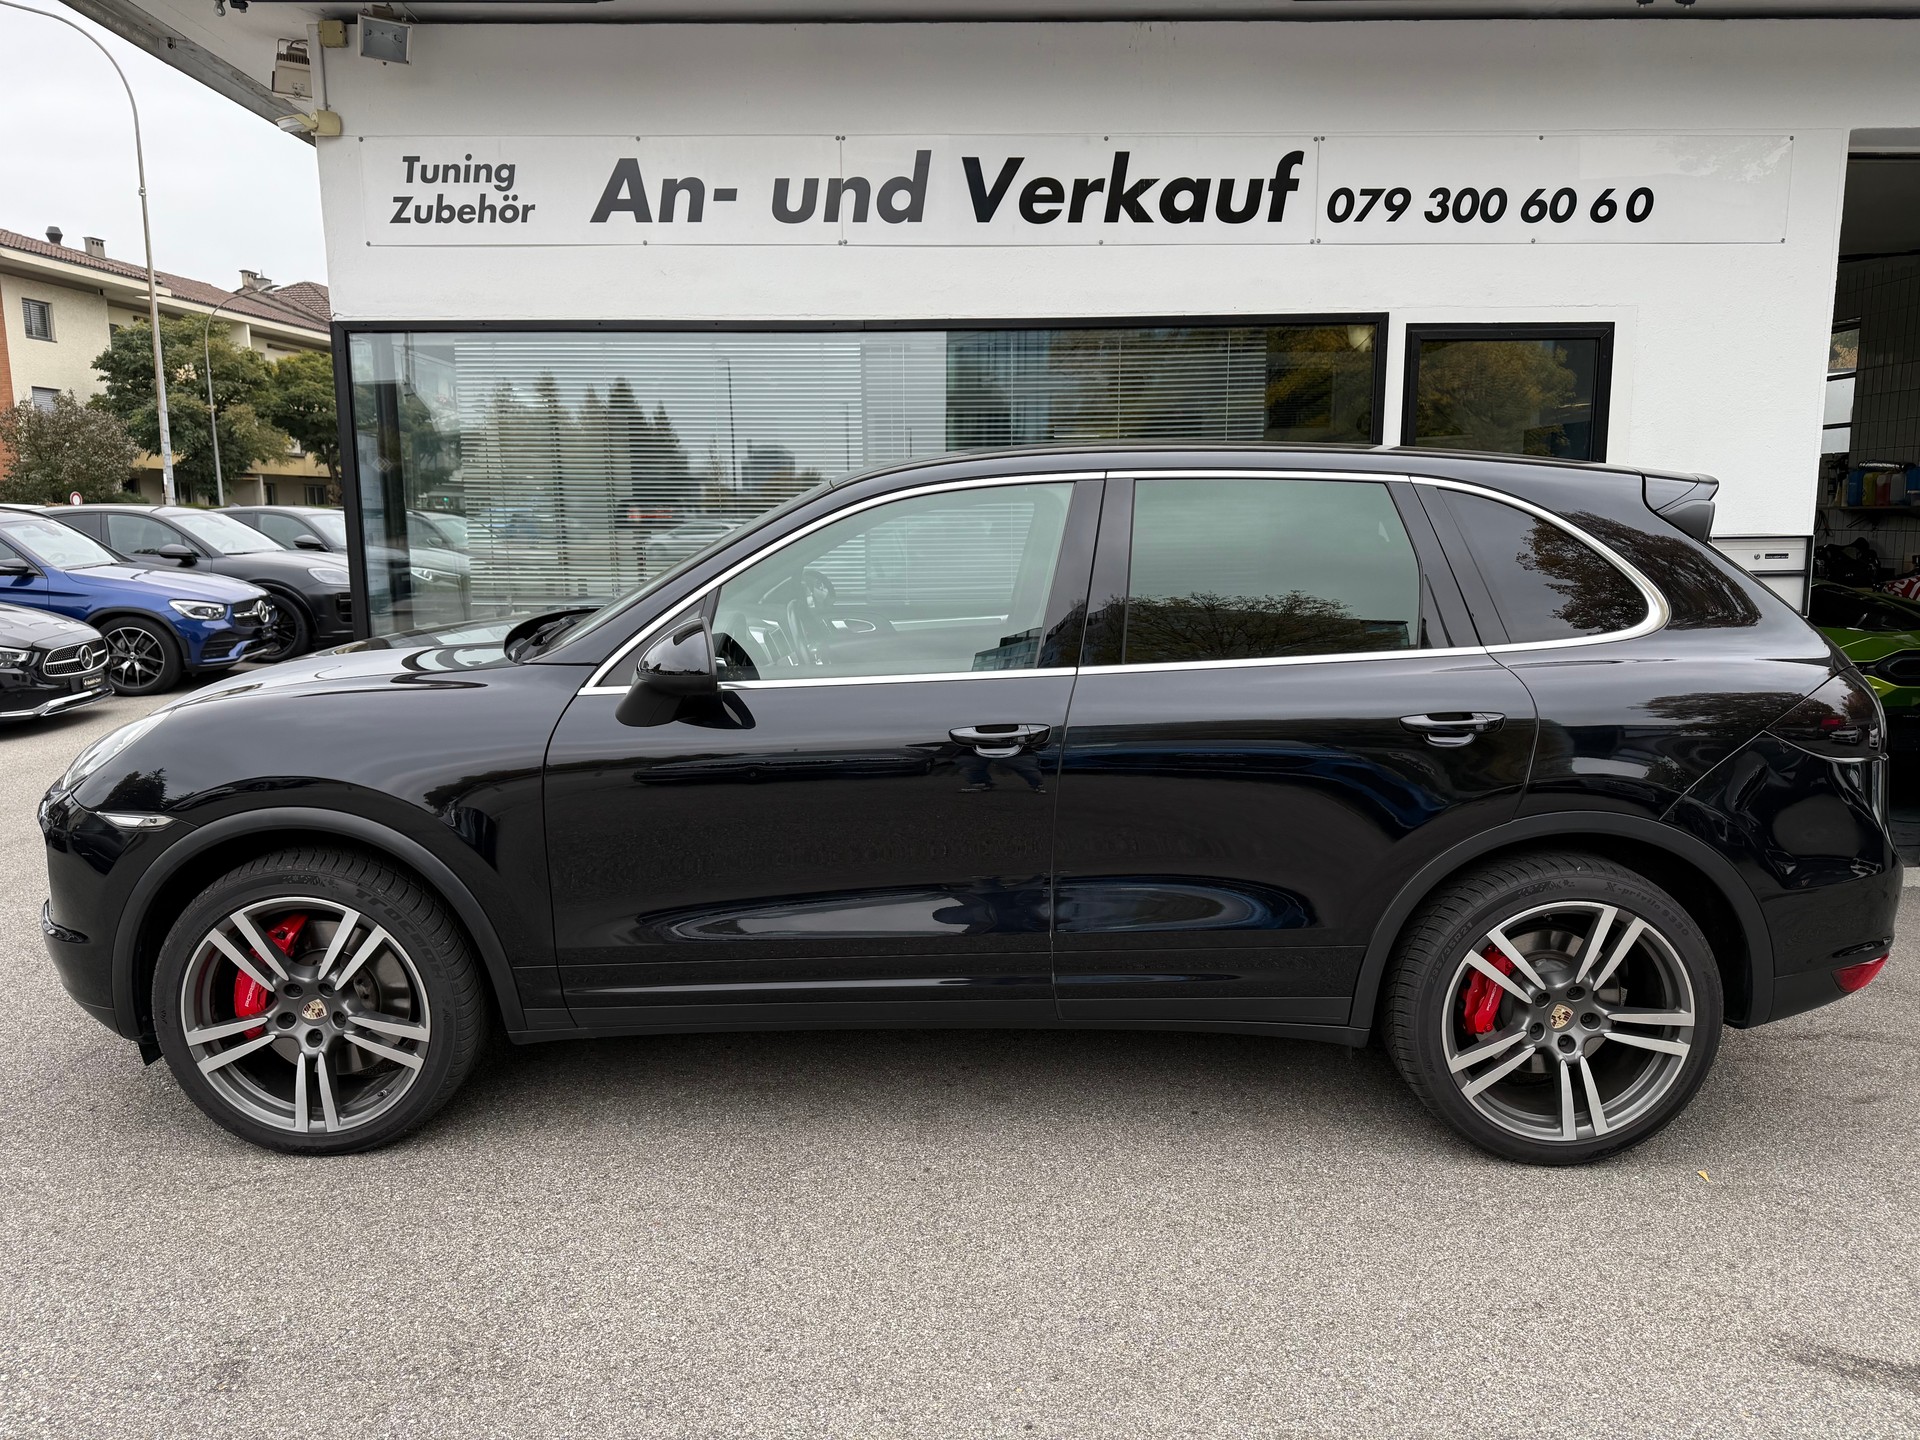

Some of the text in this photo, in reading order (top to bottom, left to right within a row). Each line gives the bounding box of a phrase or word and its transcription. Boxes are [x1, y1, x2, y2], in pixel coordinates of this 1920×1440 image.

[403, 154, 516, 192] Tuning
[590, 150, 1305, 224] An- und Verkauf
[390, 194, 536, 224] Zubehör
[1327, 187, 1655, 224] 079 300 60 60
